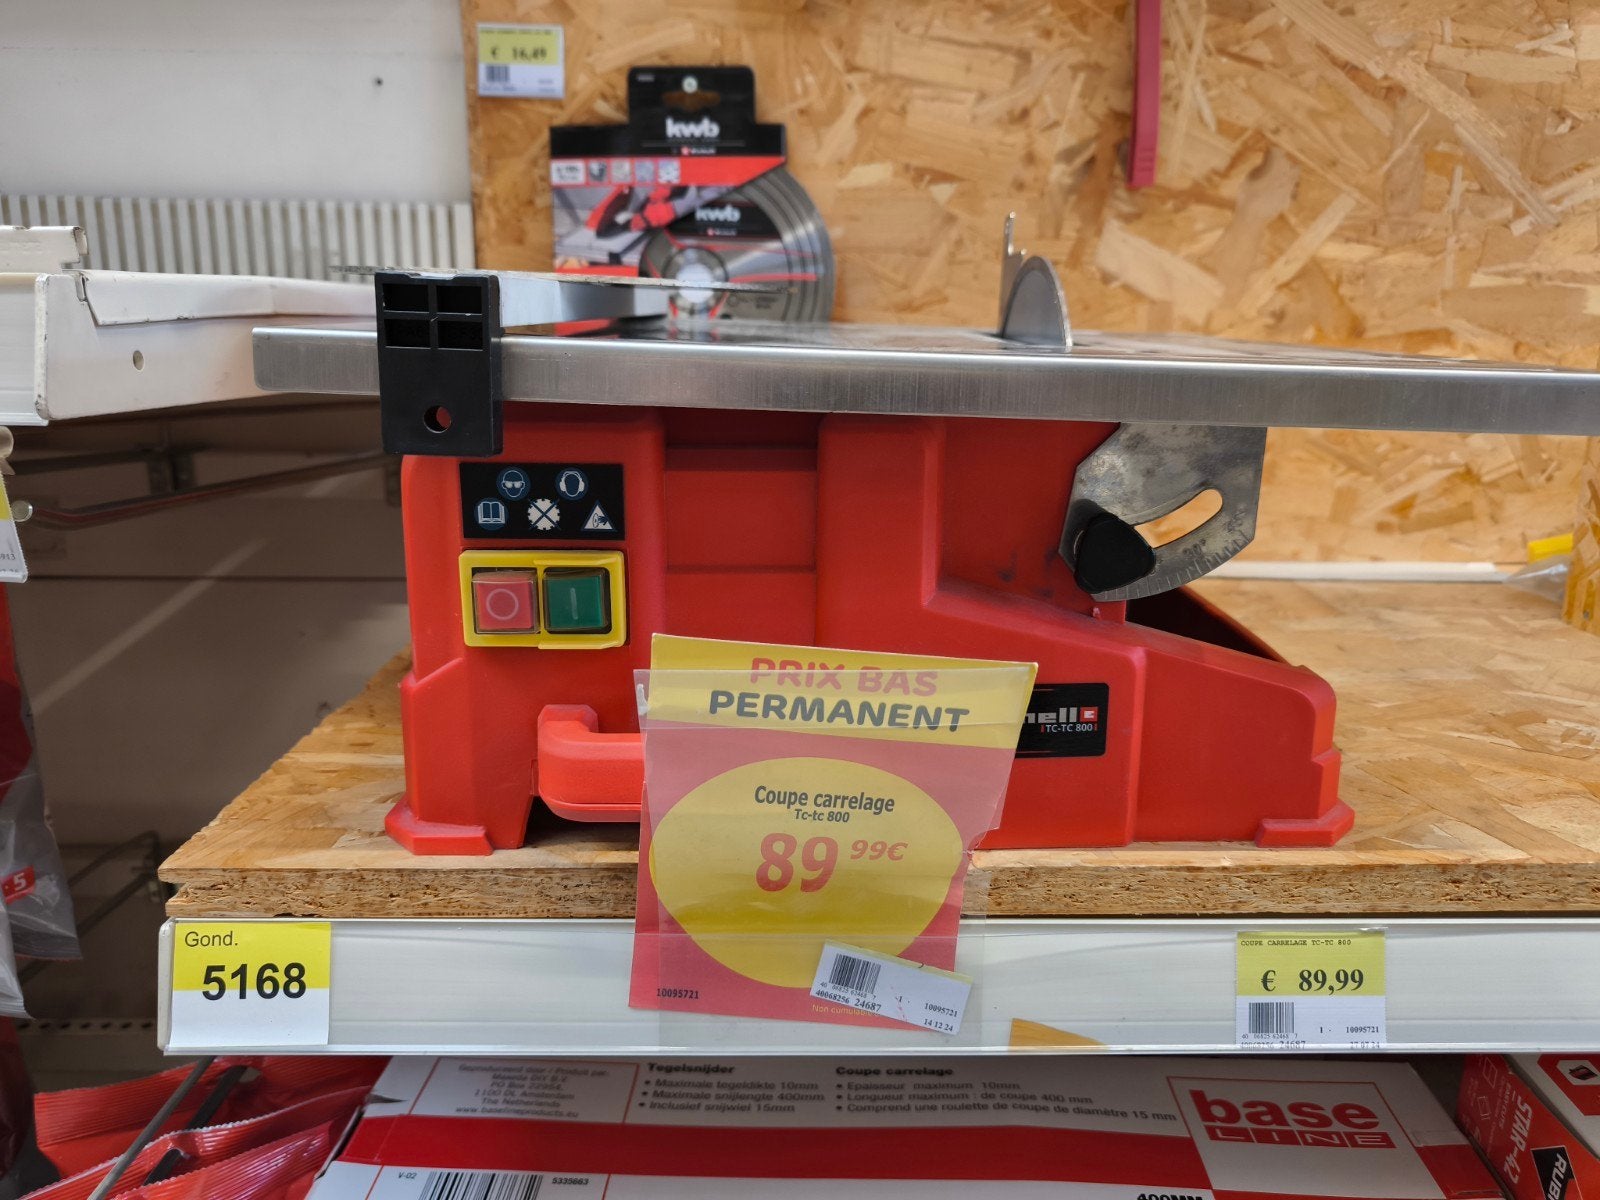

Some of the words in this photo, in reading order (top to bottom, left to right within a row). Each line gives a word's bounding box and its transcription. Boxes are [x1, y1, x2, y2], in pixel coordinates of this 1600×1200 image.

[666, 116, 720, 138] kwb
[695, 204, 741, 222] kwb
[750, 656, 846, 690] PRIX
[857, 665, 939, 697] BAS
[708, 689, 970, 732] PERMANENT
[1046, 724, 1073, 733] TC-TC
[1075, 723, 1093, 732] 800
[754, 785, 809, 809] Coupe
[813, 792, 895, 815] carrelage
[794, 808, 824, 822] Tc-tc
[827, 810, 850, 823] 800
[755, 832, 839, 893] 89
[850, 839, 909, 861] 99€
[13, 872, 27, 891] 5
[184, 930, 239, 947] Gond.
[1240, 939, 1263, 947] COUPE
[1267, 939, 1308, 947] CARRELAGE
[1311, 939, 1334, 947] TC-TC
[202, 962, 307, 1001] 5168
[1260, 969, 1276, 992] €
[1298, 968, 1364, 996] 89,99
[657, 988, 699, 999] 10095721
[815, 989, 850, 1004] 40068256
[854, 998, 882, 1012] 24687
[812, 1004, 829, 1013] Non
[924, 1002, 959, 1017] 10095721
[648, 1062, 735, 1075] Tegelsnijder
[835, 1066, 881, 1077] Coupe
[886, 1066, 954, 1077] carrelage
[655, 1078, 713, 1089] Maximale
[847, 1081, 905, 1091] Epaisseur
[913, 1081, 973, 1090] maximum
[982, 1081, 1020, 1090] 10mm
[652, 1089, 711, 1099] Maximale
[777, 1092, 825, 1101] 400mm
[848, 1092, 904, 1102] Longueur
[908, 1092, 969, 1100] maximum
[980, 1091, 996, 1100] de
[1000, 1092, 1037, 1102] coupe
[1041, 1094, 1064, 1103] 400
[1068, 1096, 1093, 1104] mm
[649, 1101, 701, 1111] Inclusief
[756, 1103, 796, 1112] 15mm
[847, 1102, 911, 1113] Comprend
[914, 1104, 938, 1112] une
[942, 1102, 989, 1111] roulette
[992, 1102, 1008, 1110] de
[1012, 1103, 1050, 1113] coupe
[1053, 1104, 1069, 1114] de
[1132, 1110, 1149, 1119] 15
[1151, 1112, 1177, 1121] mm
[1189, 1089, 1381, 1130] base
[1215, 1128, 1389, 1146] LINE
[1503, 1094, 1533, 1185] STAR-42
[398, 1172, 418, 1180] V-02
